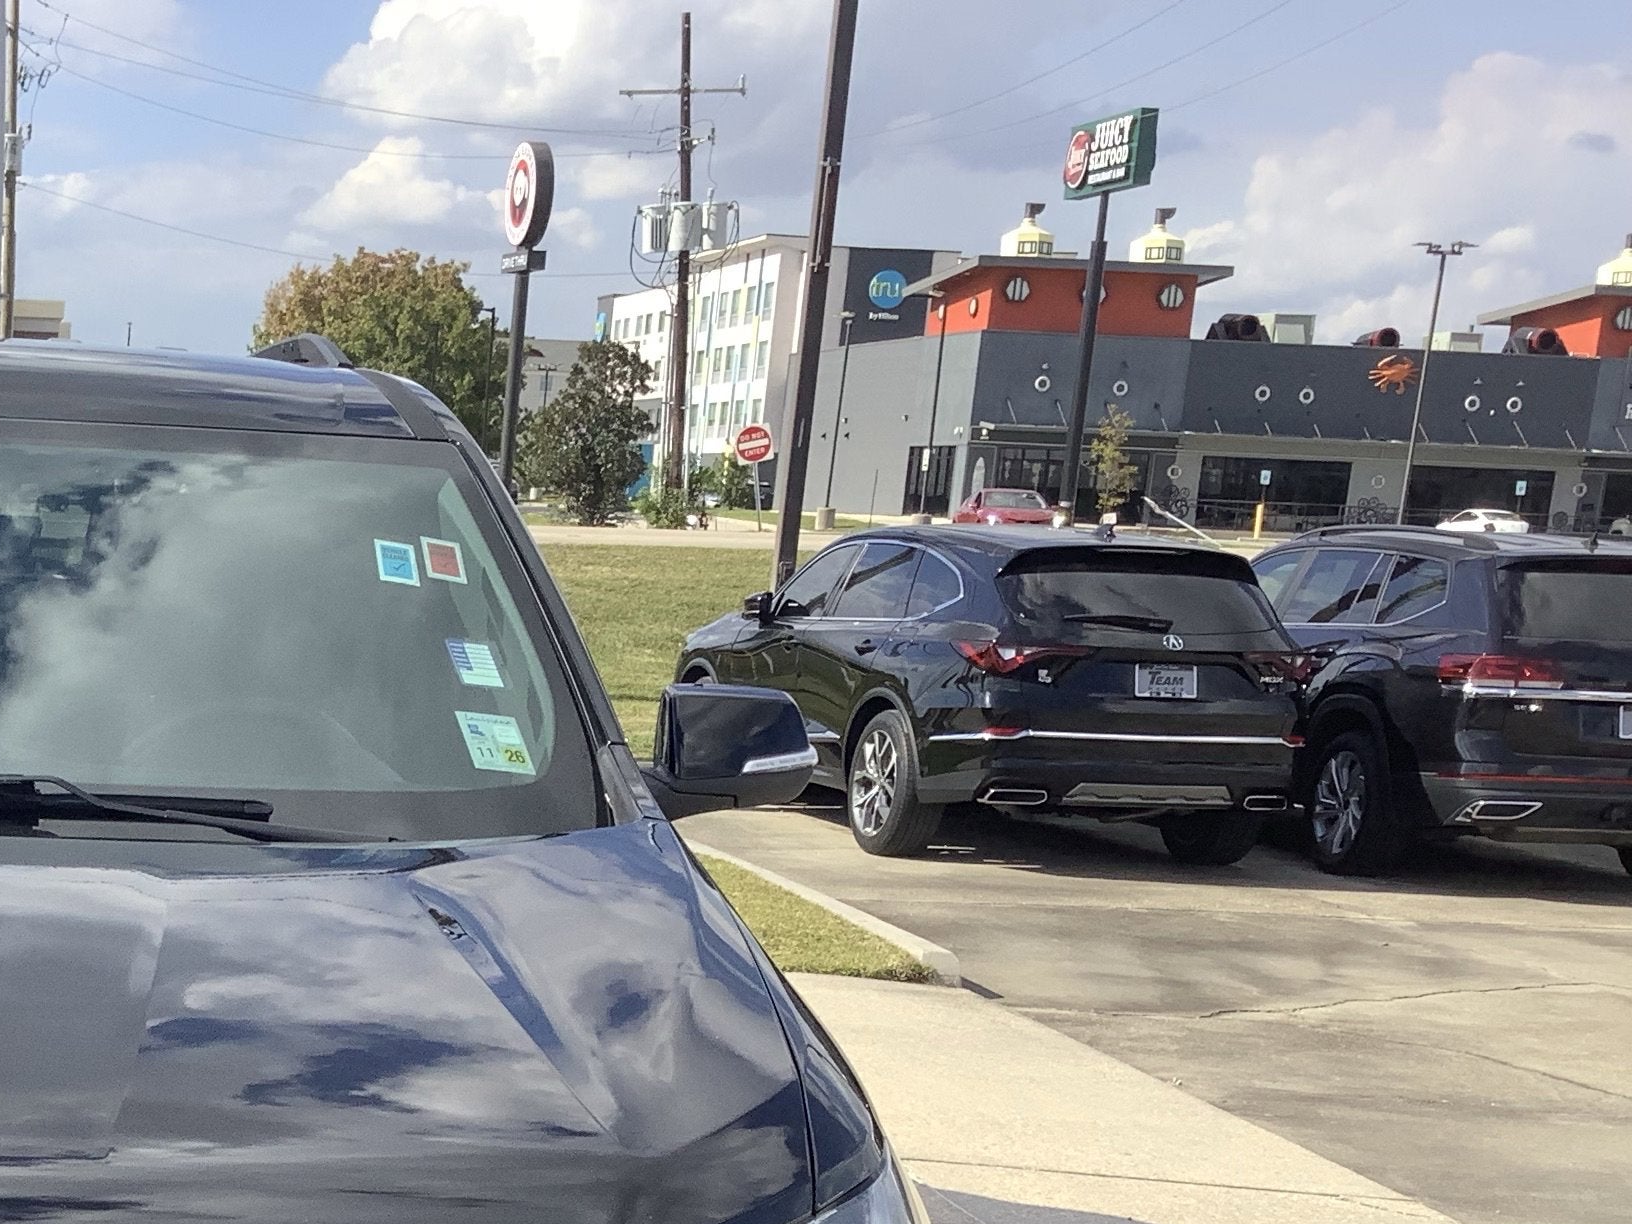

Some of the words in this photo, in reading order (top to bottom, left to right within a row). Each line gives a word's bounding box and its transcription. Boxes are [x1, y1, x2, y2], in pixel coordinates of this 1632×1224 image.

[1090, 115, 1134, 151] JUICY
[1088, 144, 1129, 171] SEAFOOD
[871, 277, 899, 297] tru
[745, 447, 765, 457] ENTER
[1148, 670, 1184, 686] TEAM
[477, 747, 494, 757] 11
[505, 749, 525, 763] 26
